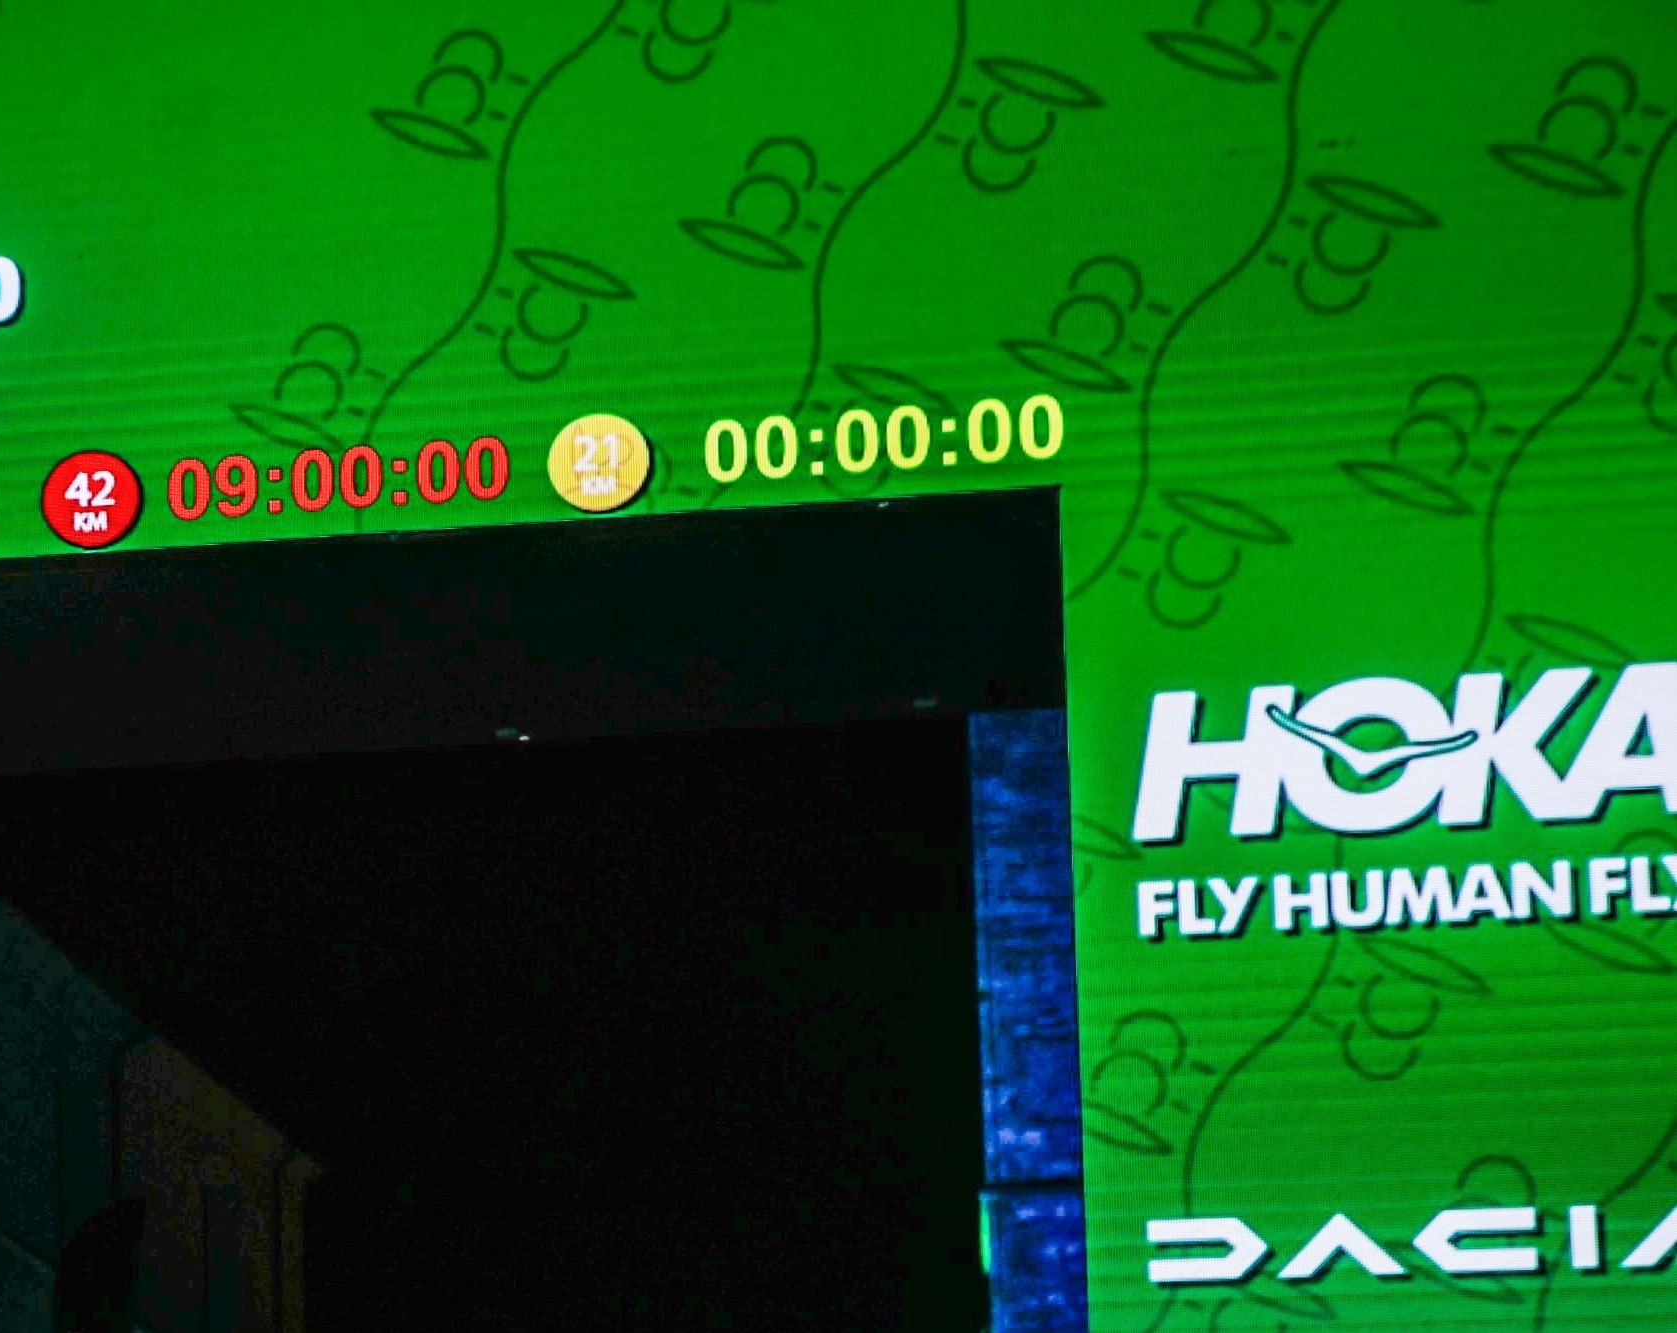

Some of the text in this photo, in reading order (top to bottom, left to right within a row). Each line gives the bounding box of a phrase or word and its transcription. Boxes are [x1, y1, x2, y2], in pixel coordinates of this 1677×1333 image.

[573, 432, 621, 472] 21
[704, 394, 1064, 483] 00:00:00
[64, 470, 117, 509] 42
[167, 436, 509, 521] 09:00:00
[73, 510, 109, 532] KM
[1137, 875, 1259, 937] FLY
[1272, 859, 1574, 932] HUMAN
